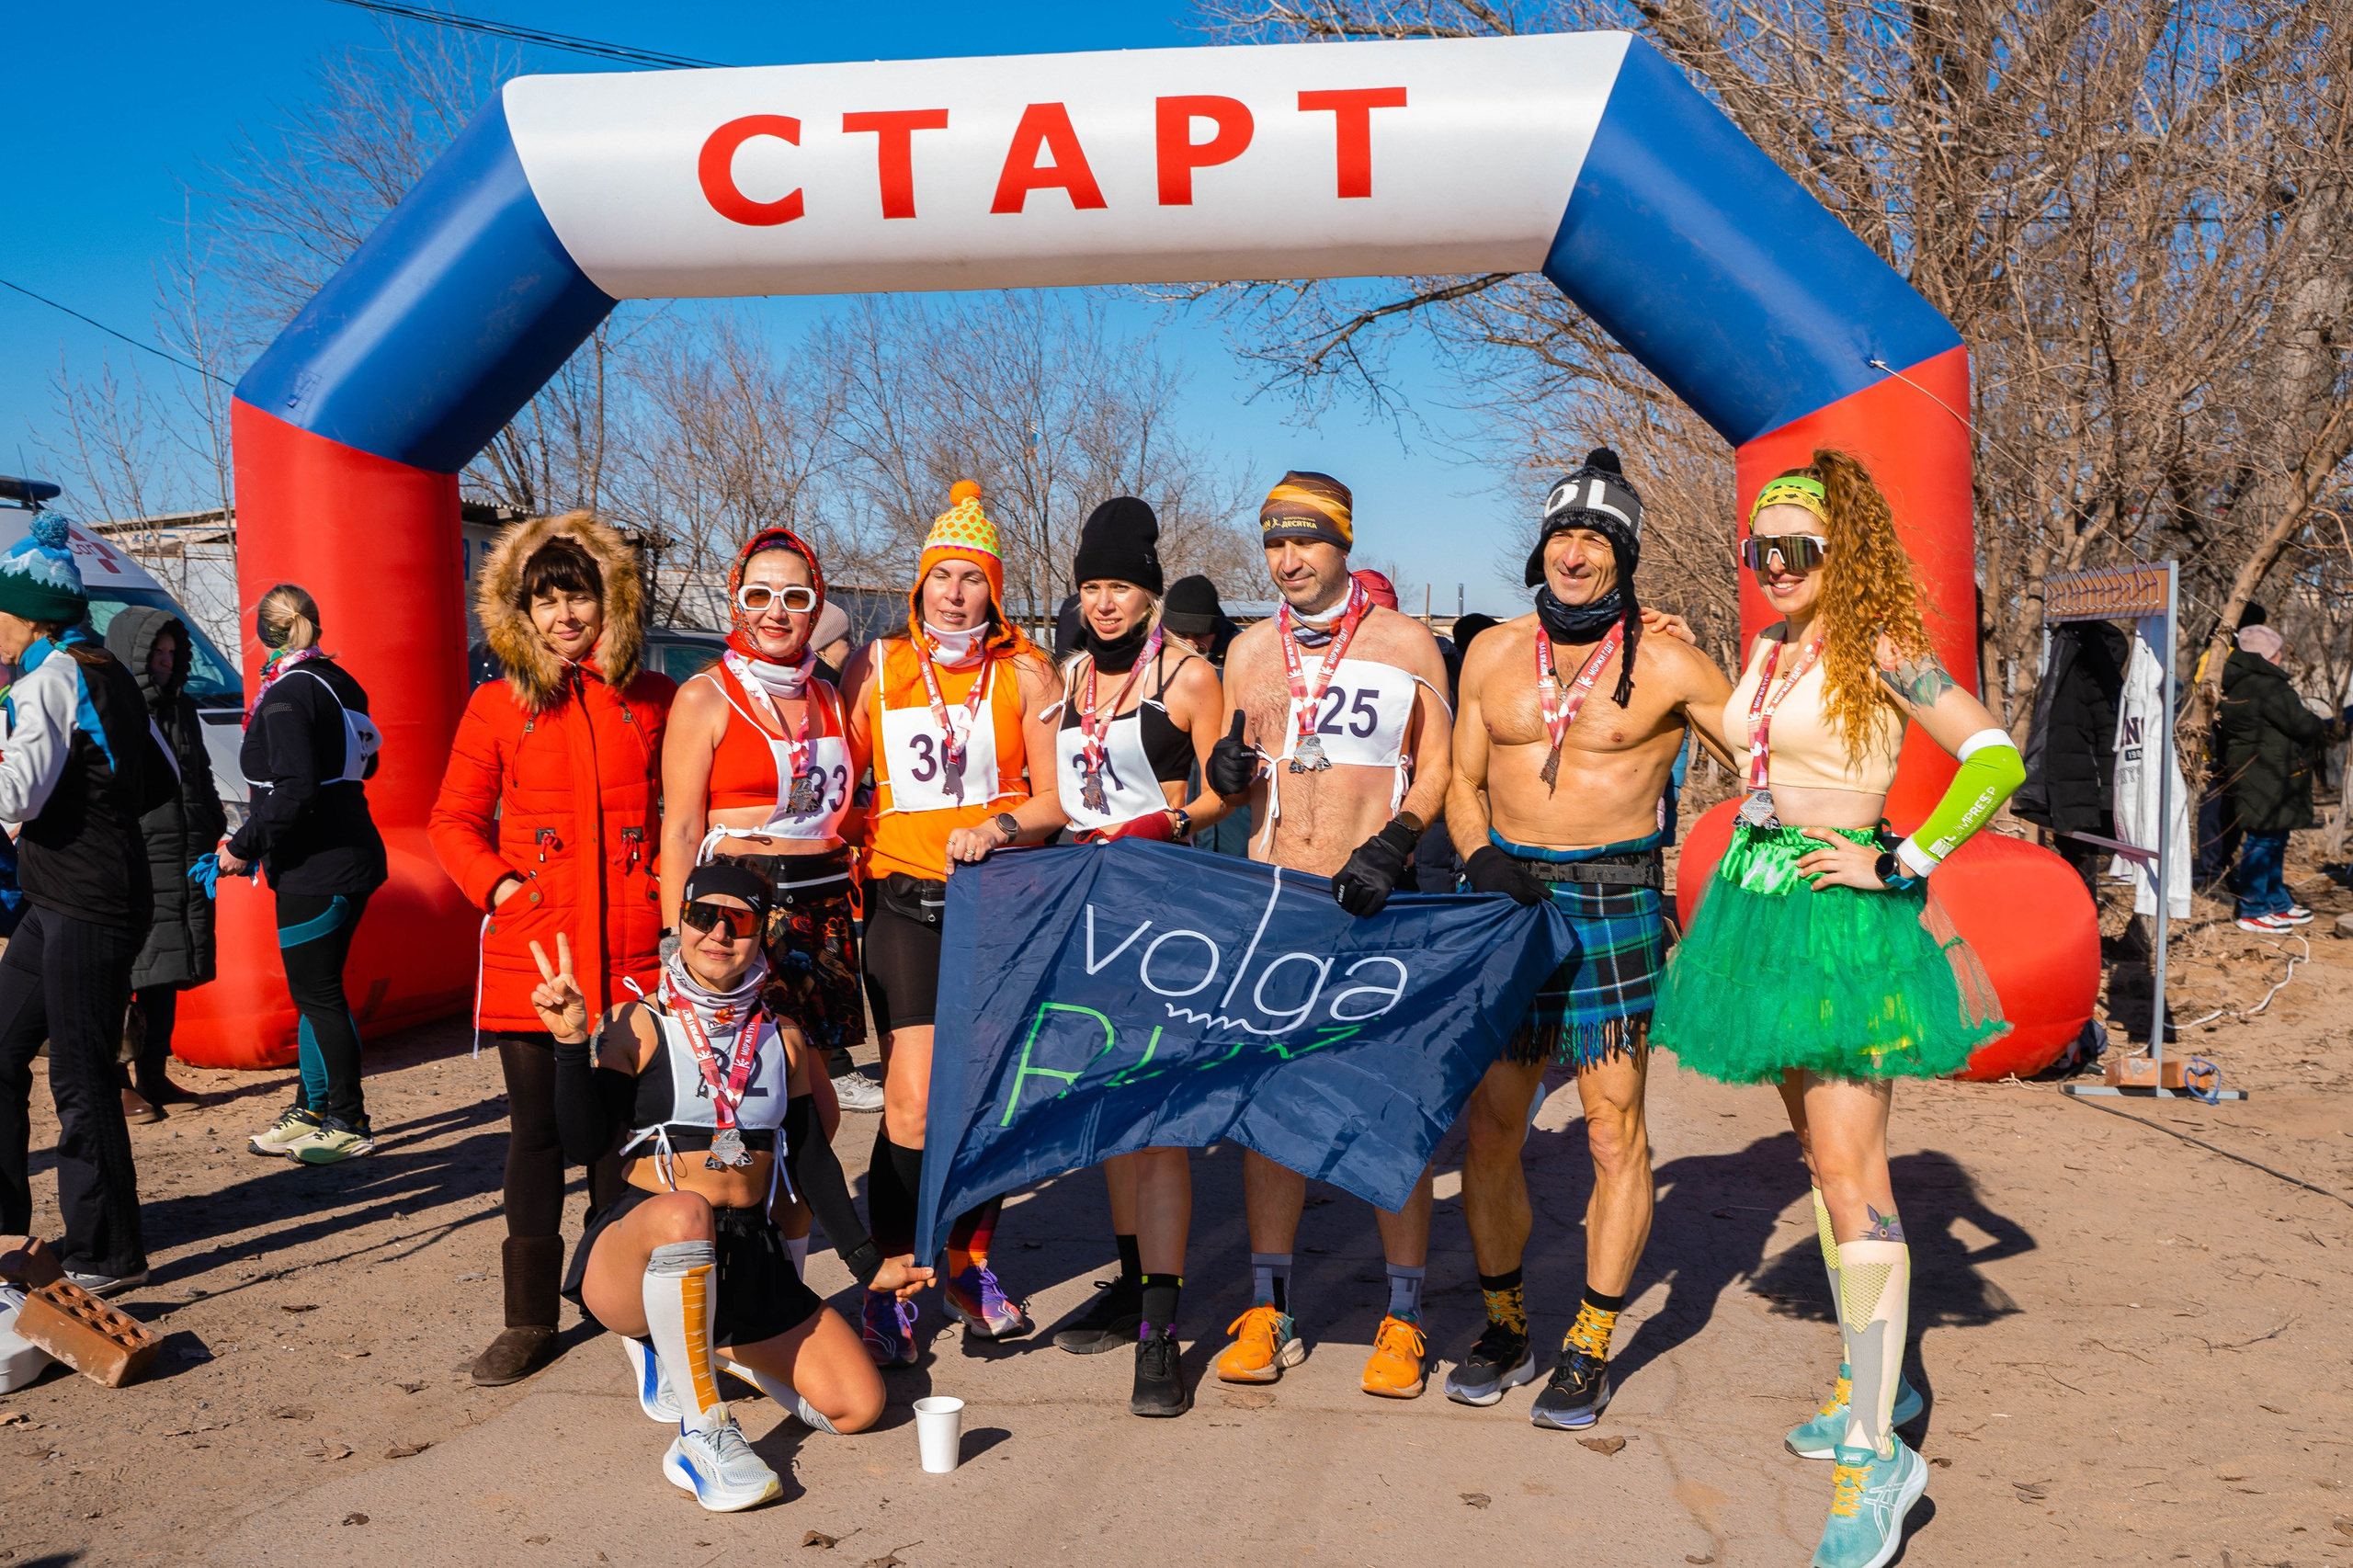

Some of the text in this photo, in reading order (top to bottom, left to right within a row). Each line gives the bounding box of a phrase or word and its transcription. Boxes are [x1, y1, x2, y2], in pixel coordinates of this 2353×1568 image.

[698, 86, 1407, 226] СТАРТ
[1281, 520, 1318, 529] ДЕСЯТКА
[1327, 628, 1348, 665] МОРЖИ ГДЕ?
[1587, 640, 1615, 676] МОРЖИ ГДЕ?
[1772, 666, 1803, 704] МОРЖИ ГДЕ?
[1317, 686, 1380, 738] 25
[910, 733, 967, 782] 30
[807, 766, 847, 812] 33
[1086, 866, 1408, 1036] volga
[688, 1024, 704, 1048] МОРЖИ
[741, 1034, 754, 1056] МОРЖИ
